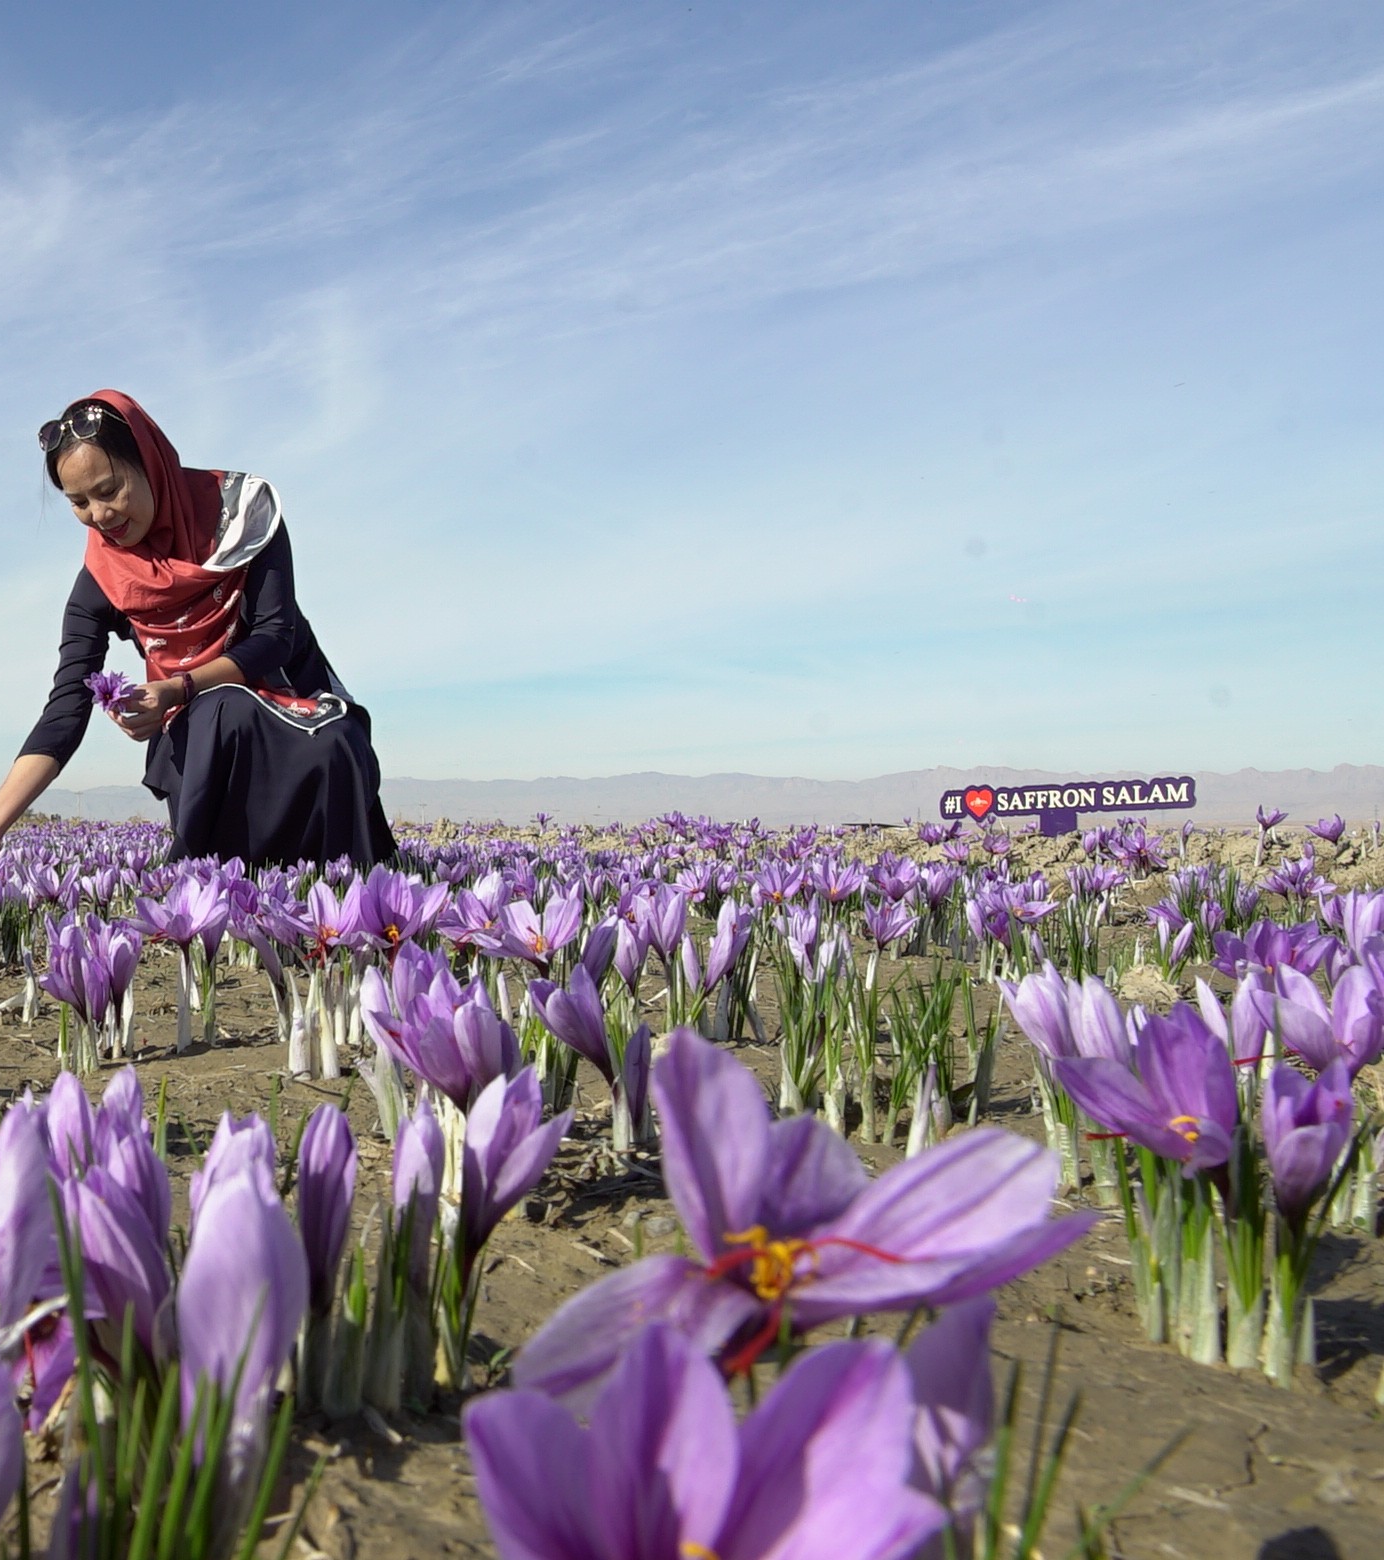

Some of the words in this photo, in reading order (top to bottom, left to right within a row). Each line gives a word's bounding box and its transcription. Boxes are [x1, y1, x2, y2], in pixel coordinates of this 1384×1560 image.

[944, 795, 962, 814] #I
[997, 787, 1096, 811] SAFFRON
[1102, 782, 1189, 806] SALAM
